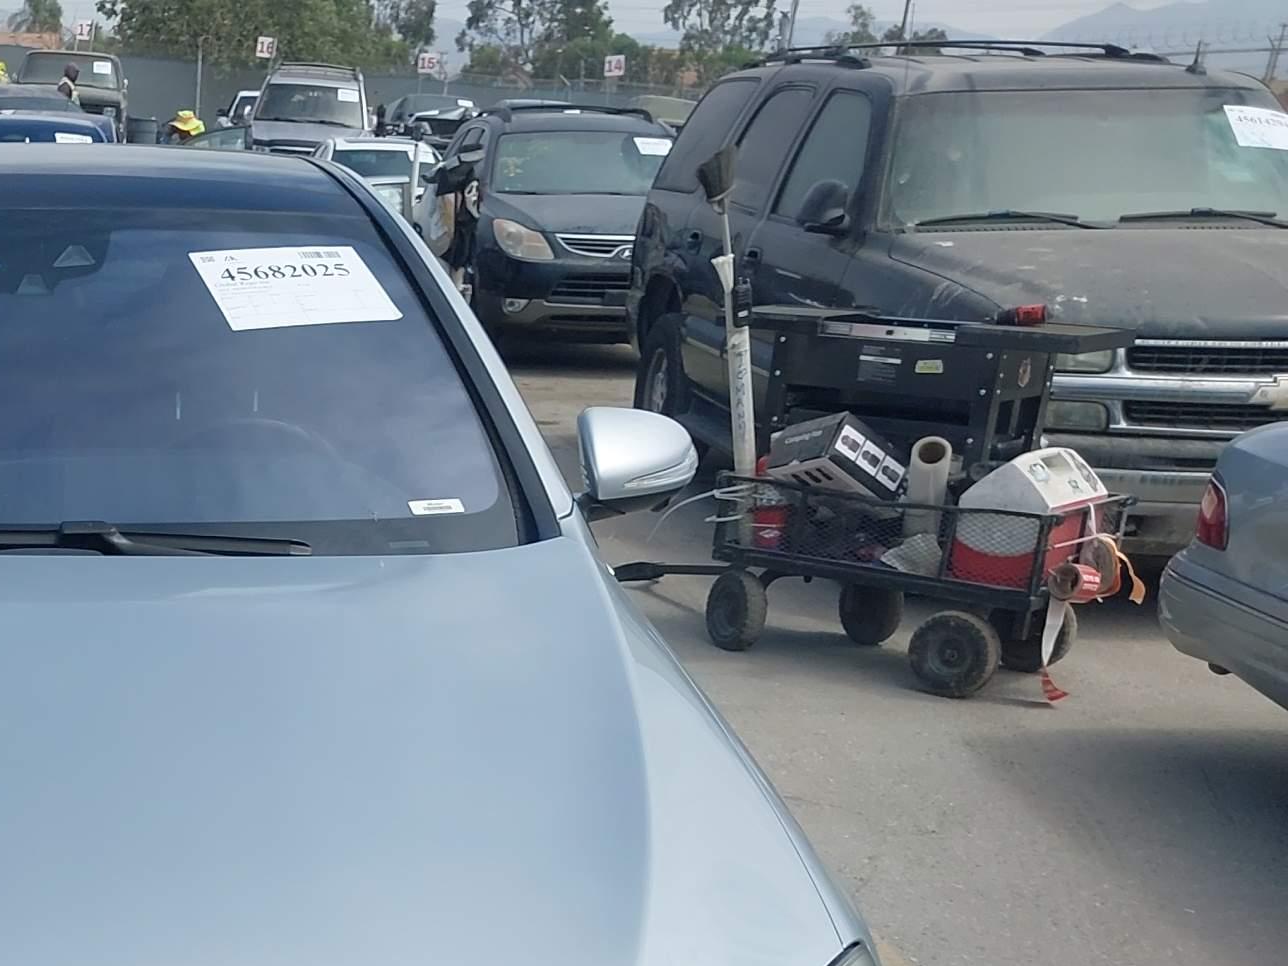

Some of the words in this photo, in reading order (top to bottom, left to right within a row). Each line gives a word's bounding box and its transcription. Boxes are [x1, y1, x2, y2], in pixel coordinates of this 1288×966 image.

[77, 23, 93, 36] 17
[258, 41, 273, 55] 16
[420, 56, 437, 70] 15
[605, 58, 623, 73] 14
[221, 263, 351, 282] 45682025
